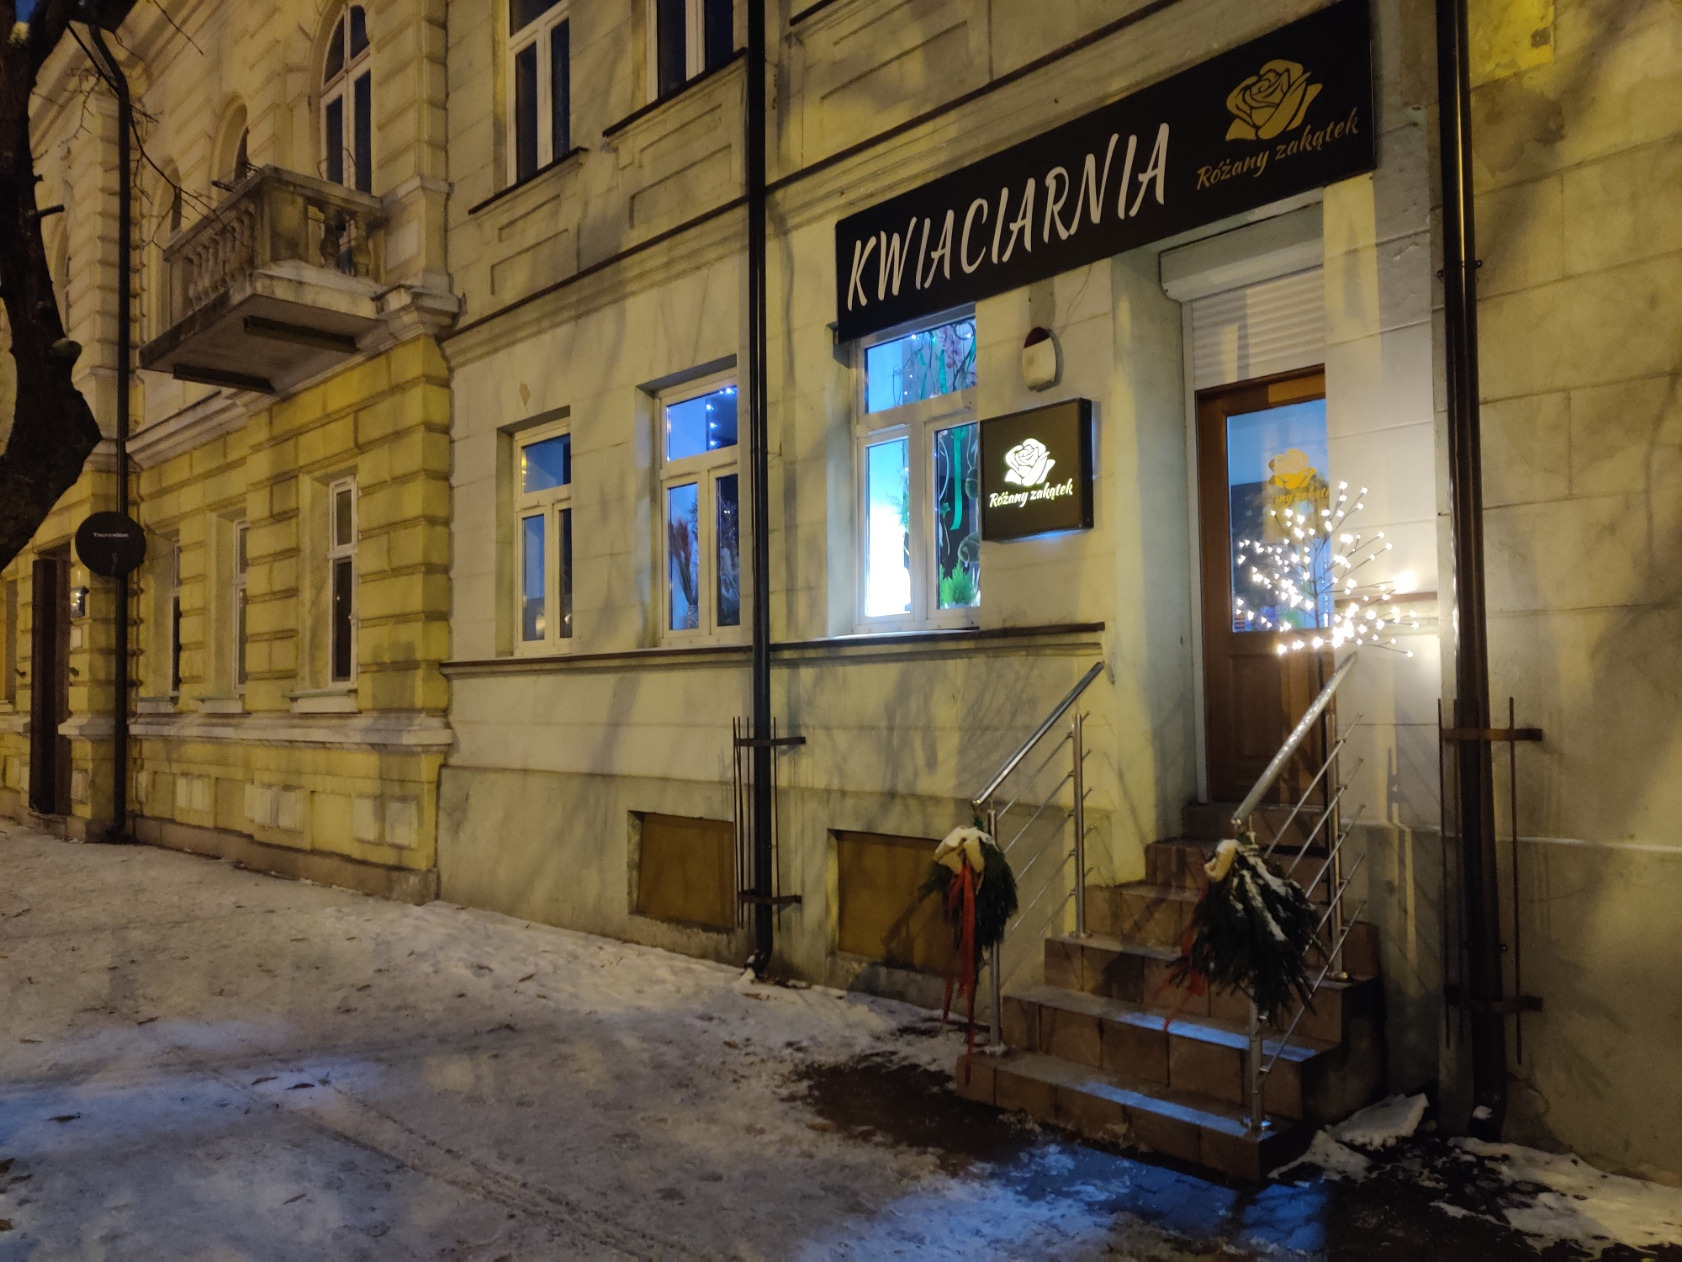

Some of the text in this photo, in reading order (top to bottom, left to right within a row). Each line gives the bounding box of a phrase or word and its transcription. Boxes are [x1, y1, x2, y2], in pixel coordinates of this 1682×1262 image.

[1196, 106, 1359, 190] Różany zakątek
[847, 122, 1171, 311] KWIACIARNIA
[989, 478, 1073, 508] Różany zakątek
